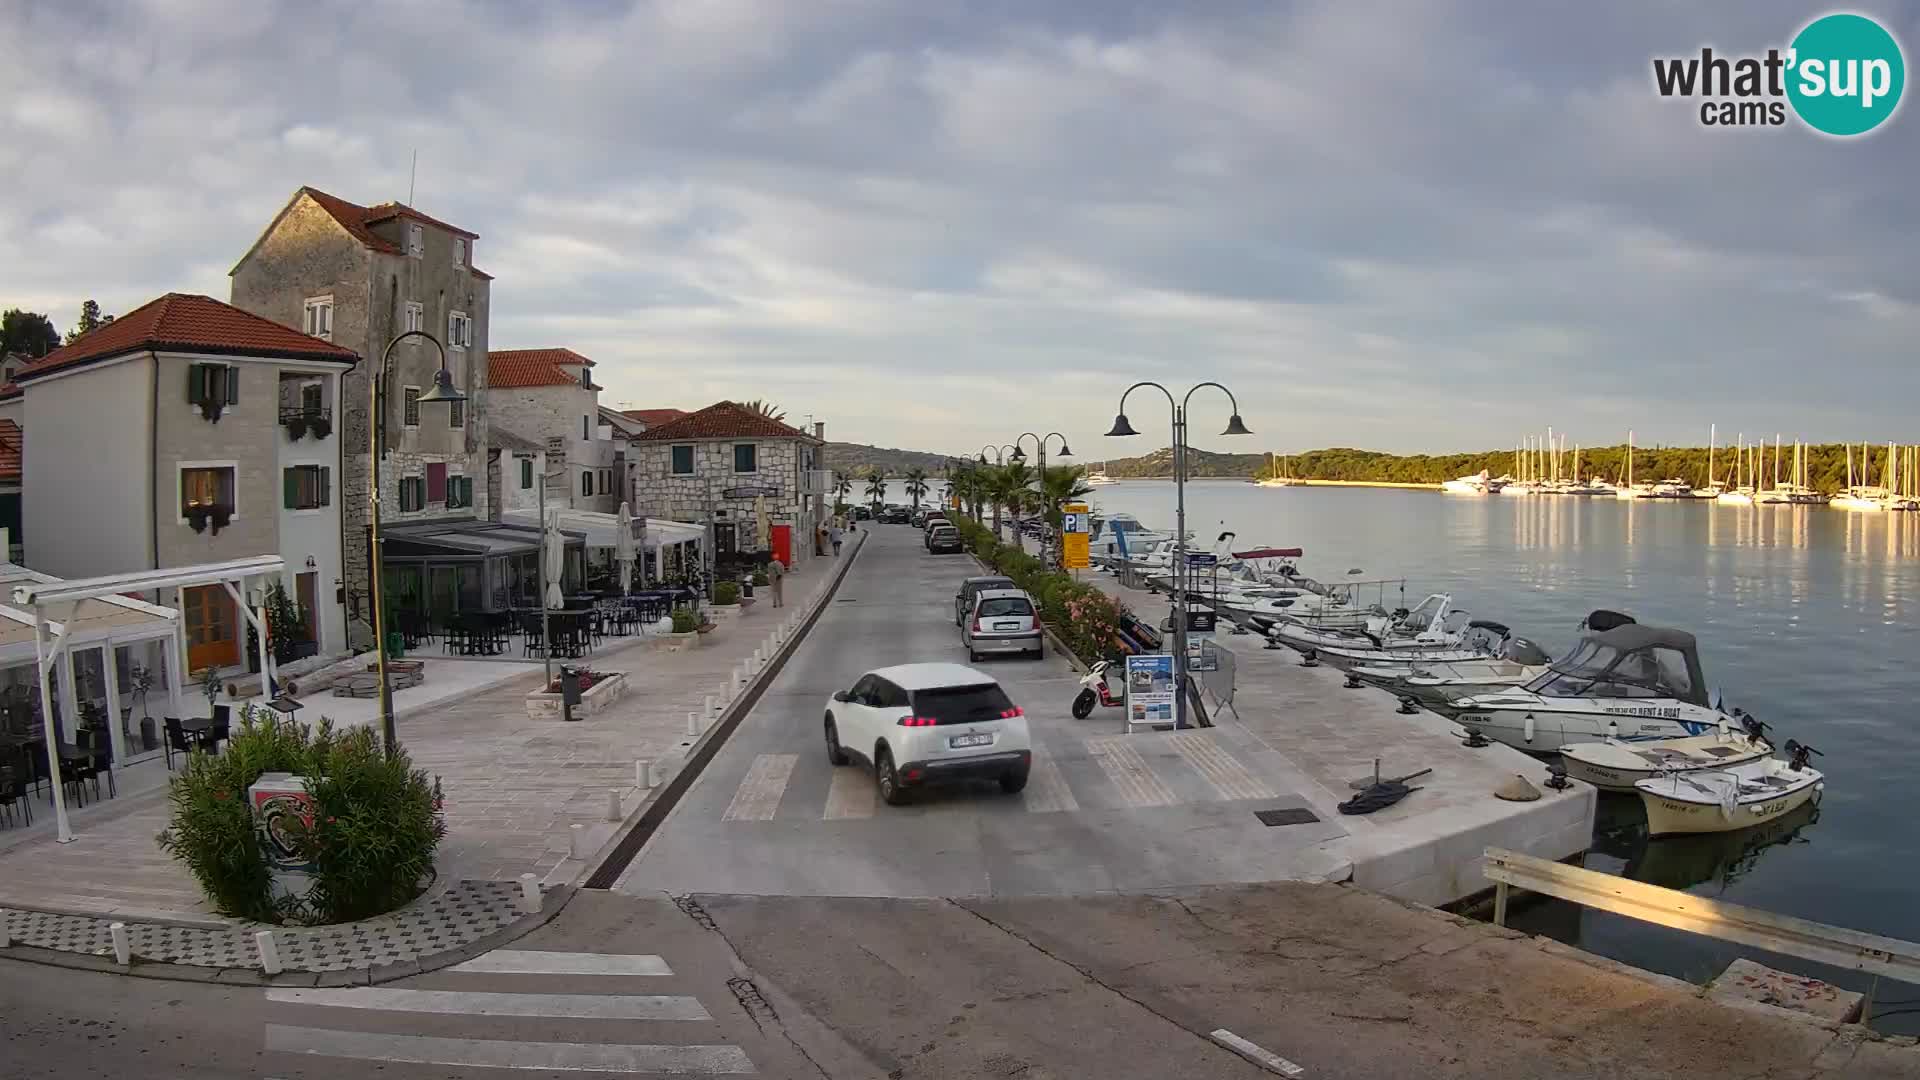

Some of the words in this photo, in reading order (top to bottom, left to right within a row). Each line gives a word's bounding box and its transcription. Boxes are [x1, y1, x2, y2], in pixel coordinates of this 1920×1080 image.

[1065, 515, 1075, 530] P
[1638, 707, 1657, 717] RENT
[1663, 707, 1681, 718] BOAT
